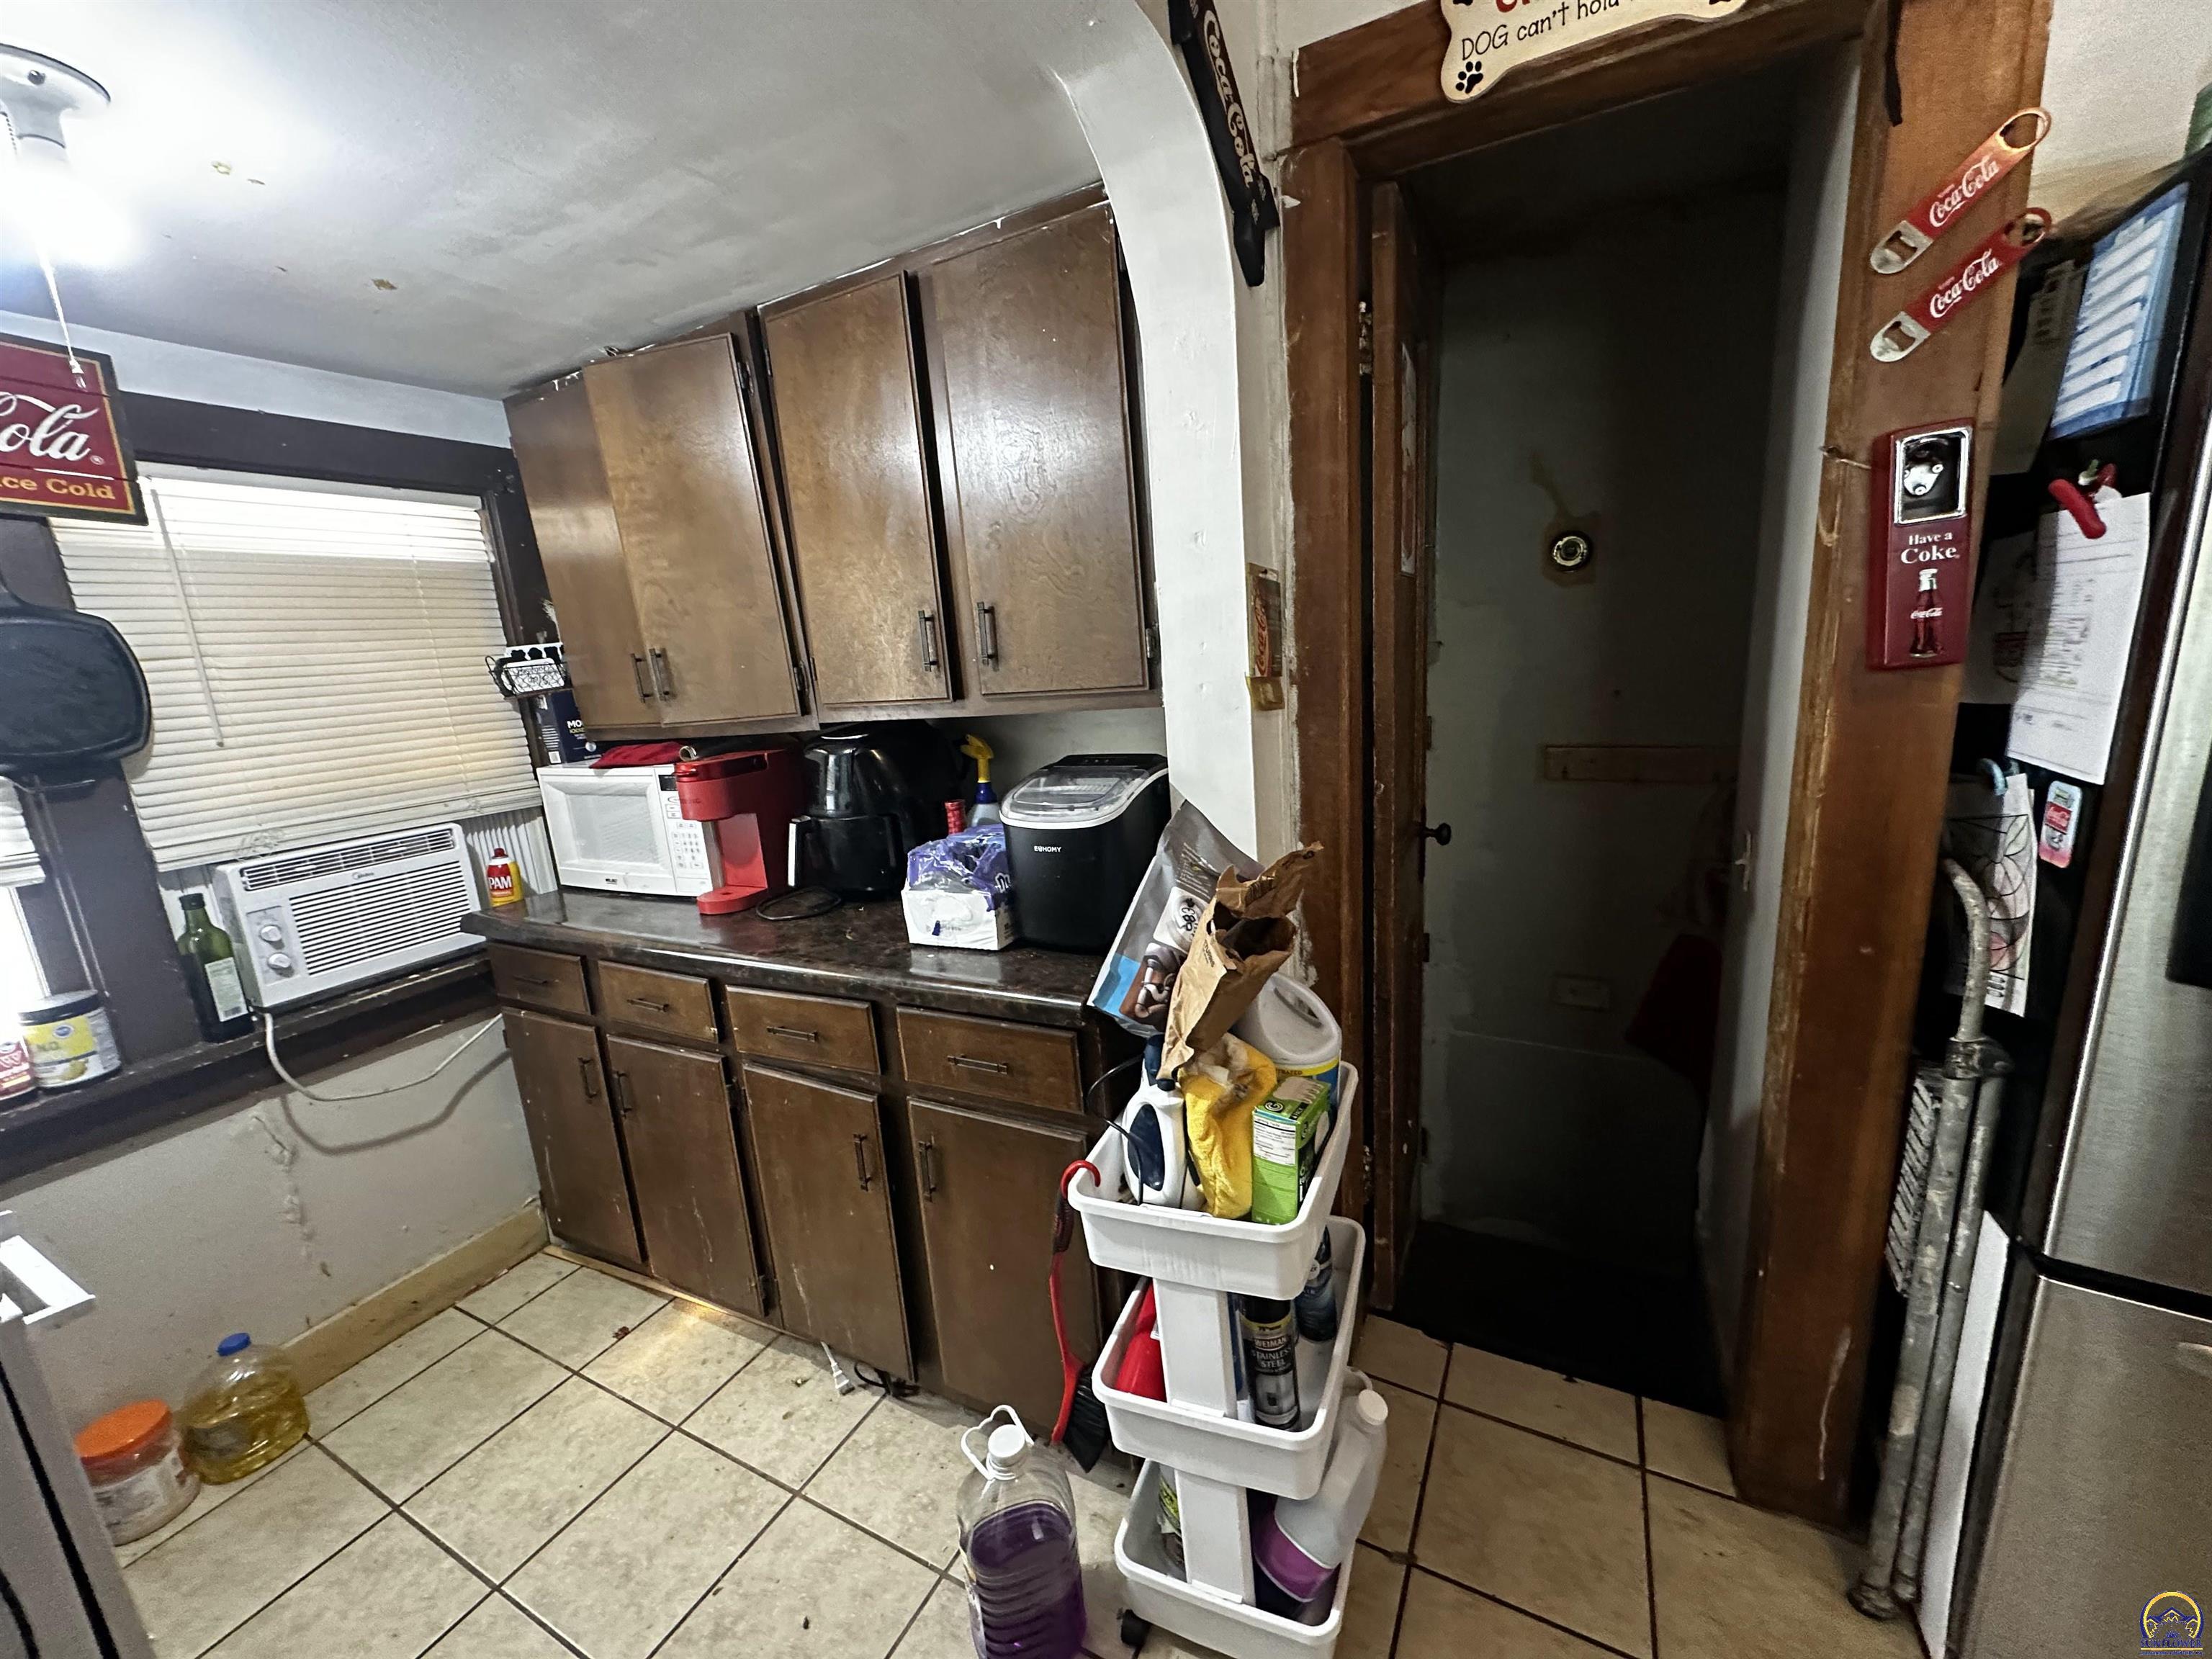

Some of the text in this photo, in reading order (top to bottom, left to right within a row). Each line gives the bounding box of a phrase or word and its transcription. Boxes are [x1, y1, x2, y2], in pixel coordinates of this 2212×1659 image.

[1461, 24, 1509, 60] DOG
[1516, 2, 1570, 42] can't
[0, 476, 116, 500] ce Cold
[1909, 532, 1953, 546] Have a
[1900, 544, 1957, 565] Coke
[488, 876, 512, 890] PAM
[1254, 1337, 1287, 1348] WEIMAN
[1260, 1359, 1285, 1368] STEEL
